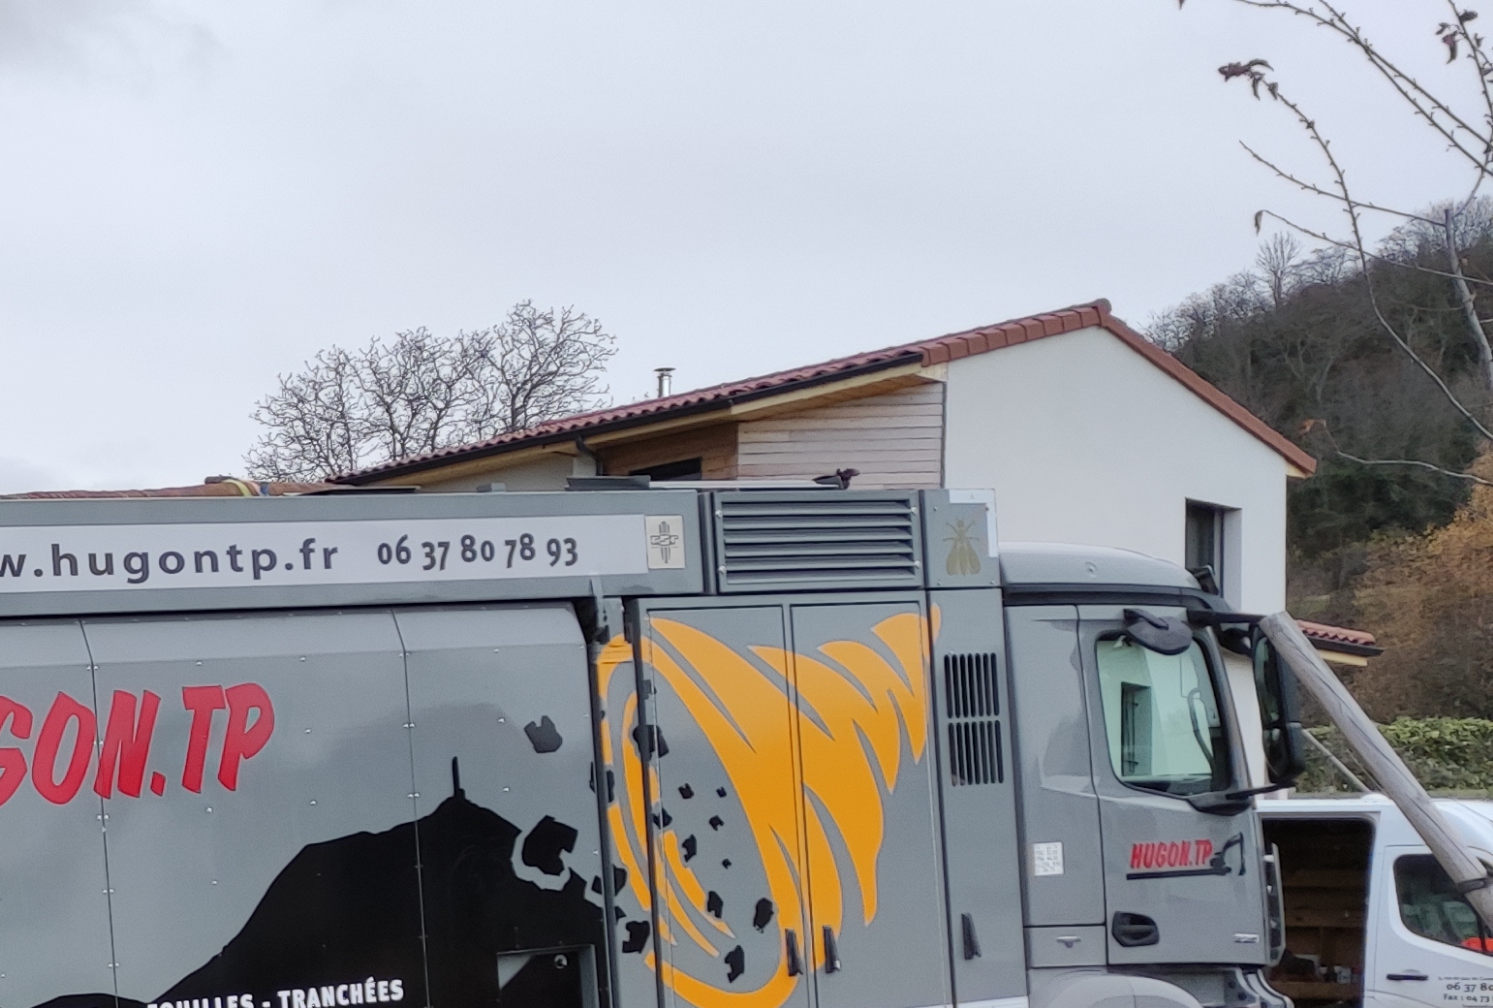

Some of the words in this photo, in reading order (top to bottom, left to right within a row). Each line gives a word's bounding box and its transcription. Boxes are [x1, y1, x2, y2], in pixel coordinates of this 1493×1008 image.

[377, 534, 412, 565] 06
[421, 541, 451, 571] 37
[460, 533, 495, 563] 80
[504, 532, 536, 568] 78
[546, 537, 579, 567] 93
[1130, 838, 1213, 869] HUGON.TP
[1446, 981, 1461, 991] 06
[1463, 984, 1477, 993] 37
